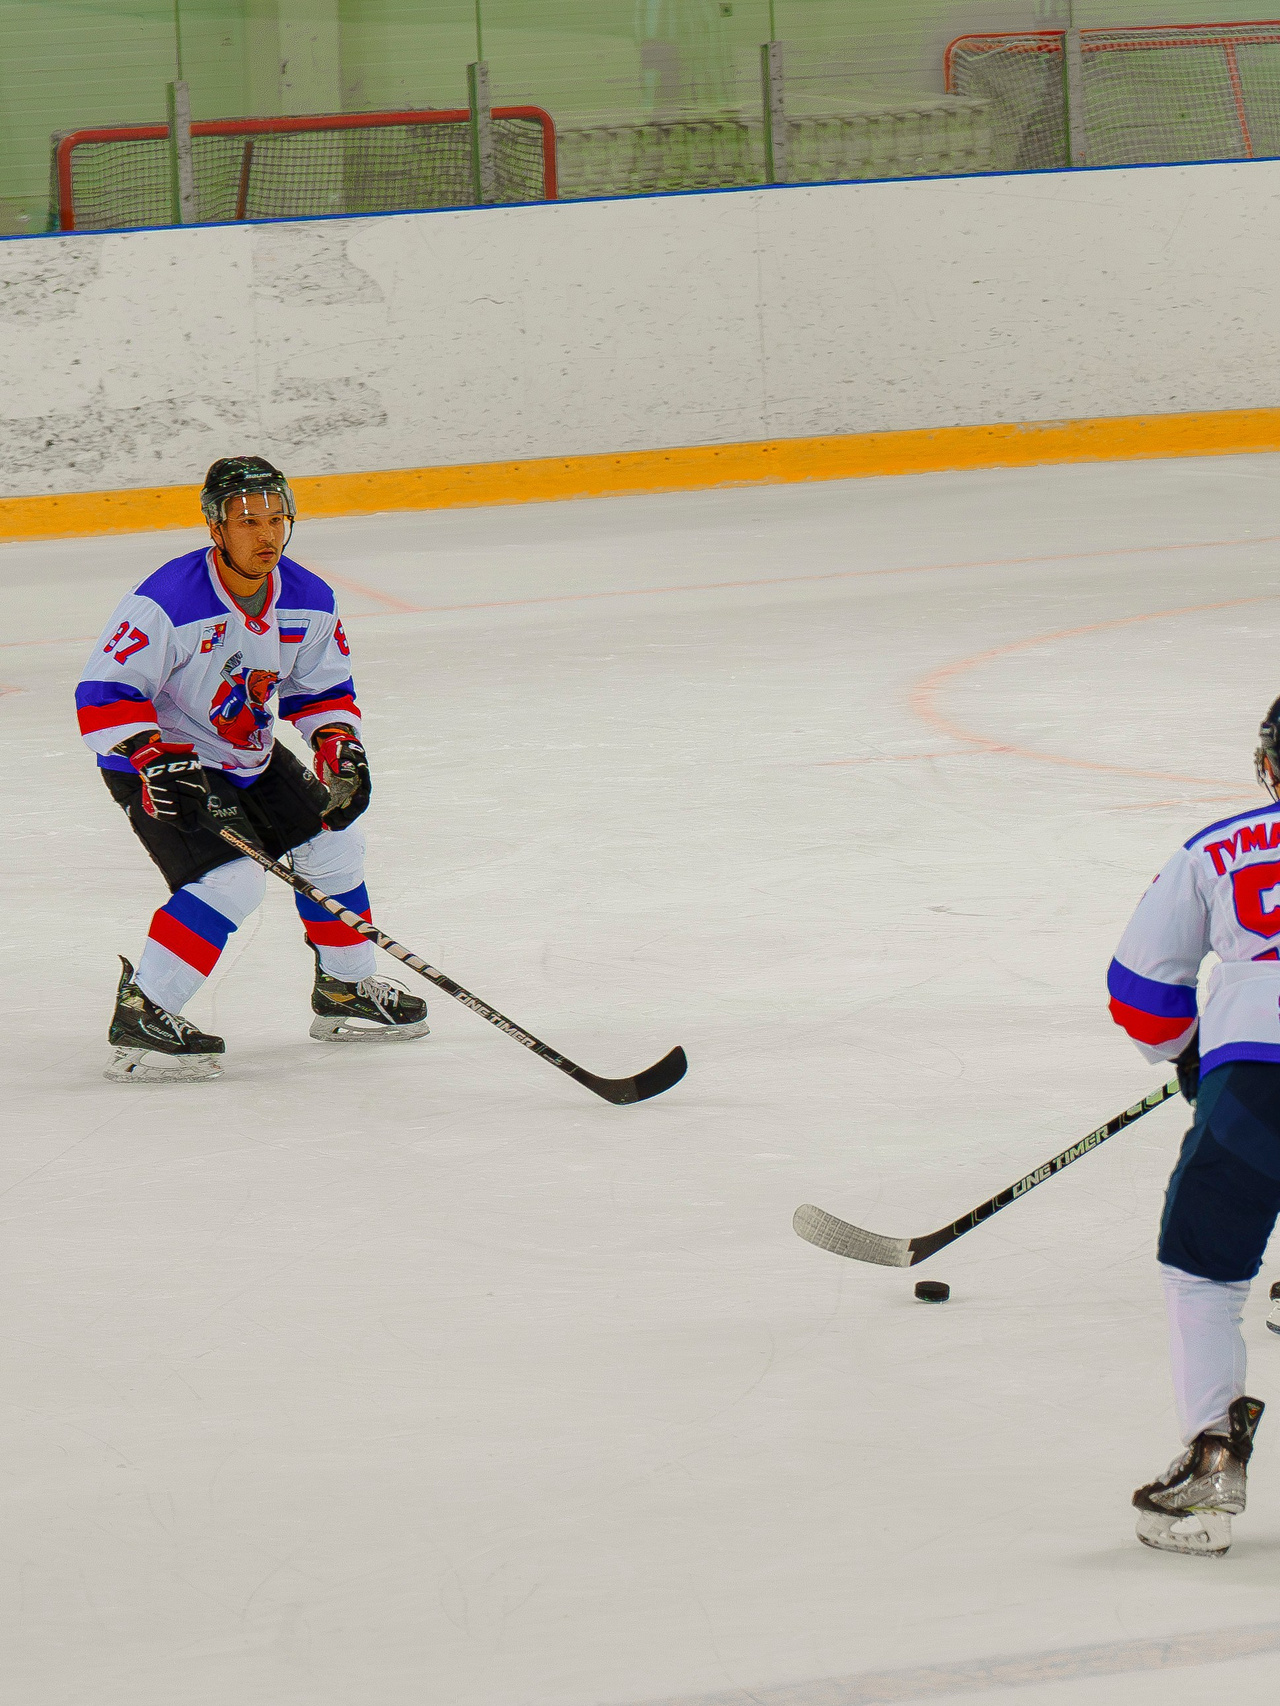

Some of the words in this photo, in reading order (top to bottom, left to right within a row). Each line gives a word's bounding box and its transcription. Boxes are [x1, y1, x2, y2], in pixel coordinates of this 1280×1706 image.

[456, 990, 491, 1017] ONE
[490, 1013, 537, 1048] TIMER
[1012, 1163, 1052, 1199] ONE
[1052, 1125, 1110, 1171] TIMER
